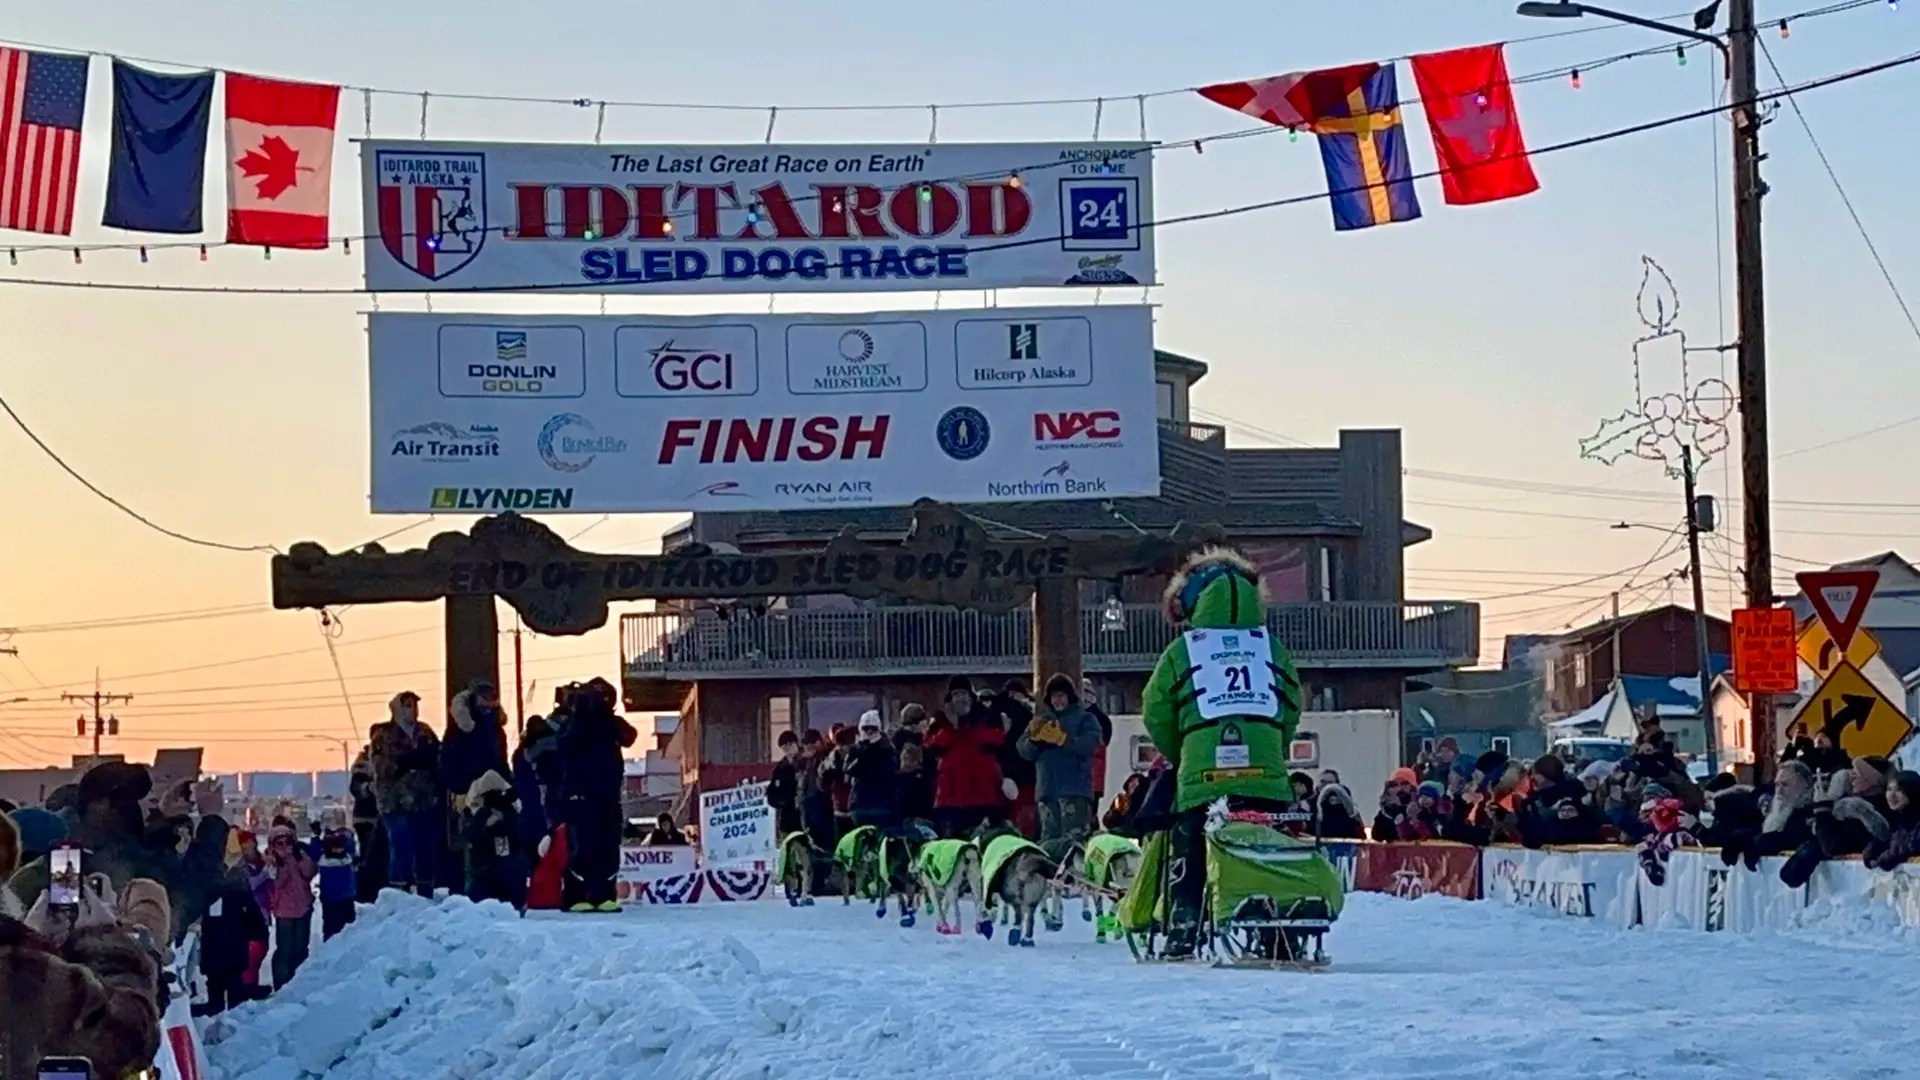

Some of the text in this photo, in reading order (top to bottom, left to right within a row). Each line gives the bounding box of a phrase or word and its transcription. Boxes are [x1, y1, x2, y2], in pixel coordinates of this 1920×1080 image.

[383, 159, 479, 174] IDITAROD TRAIL
[610, 154, 650, 173] The
[657, 155, 704, 174] Last
[709, 155, 768, 173] Great
[775, 156, 829, 173] Race
[834, 159, 862, 173] on
[1071, 163, 1127, 174] TO NME
[408, 172, 456, 186] ALASKA
[503, 180, 1033, 243] IDITAROD
[581, 244, 969, 281] SLED DOG RACE
[468, 363, 557, 379] DONLIN
[654, 352, 733, 391] GCI
[826, 363, 891, 378] HARVEST
[973, 365, 1077, 383] Hilcorp Alaska
[482, 380, 543, 393] GOLD
[813, 374, 903, 389] MIDSTREAM
[1034, 411, 1121, 440] NAC
[392, 440, 499, 456] Air Transit
[657, 414, 890, 465] FINISH
[775, 481, 872, 495] RYAN AIR
[988, 477, 1107, 498] Northrim Bank
[458, 488, 574, 509] LYNDEN
[449, 560, 527, 590] END
[603, 555, 780, 590] IDITAROD
[792, 552, 883, 585] SLED
[893, 549, 968, 585] DOG
[979, 545, 1070, 583] RACE
[1224, 665, 1252, 693] 21
[704, 786, 768, 807] IDITARO
[709, 807, 769, 827] CHAMPION
[722, 822, 757, 840] 2024
[624, 851, 673, 865] NOME
